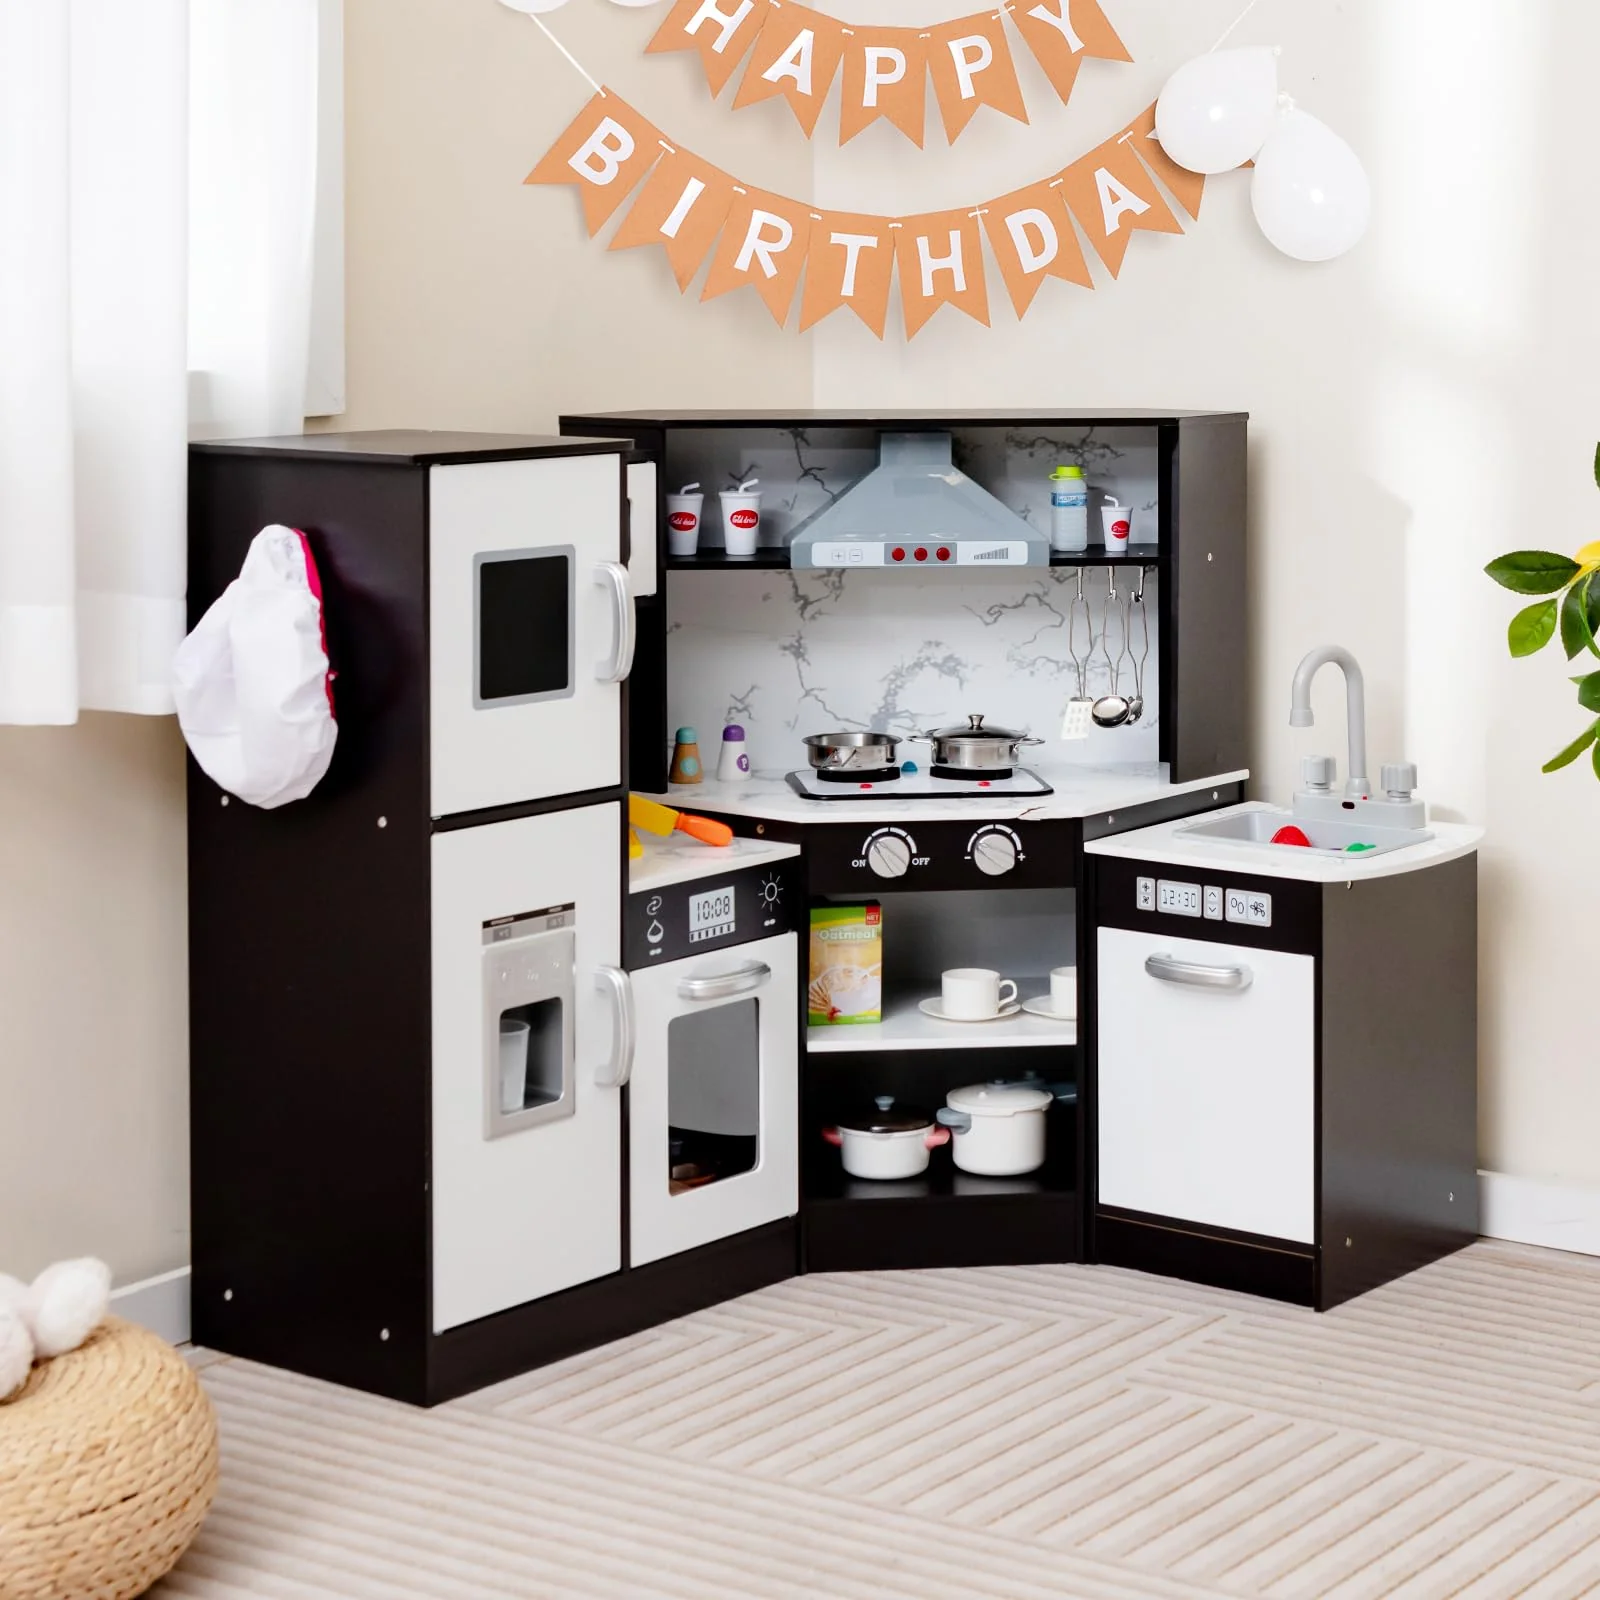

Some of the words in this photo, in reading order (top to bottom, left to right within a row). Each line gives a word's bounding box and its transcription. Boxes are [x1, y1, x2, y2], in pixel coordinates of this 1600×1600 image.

[684, 0, 1085, 107] HAPPY
[567, 116, 1158, 296] BIRTHDA
[741, 757, 748, 769] P
[851, 859, 866, 868] ON
[911, 857, 931, 866] OFF
[1162, 888, 1197, 908] 12:30
[697, 895, 730, 922] 10:08
[819, 927, 876, 940] Oatmeal
